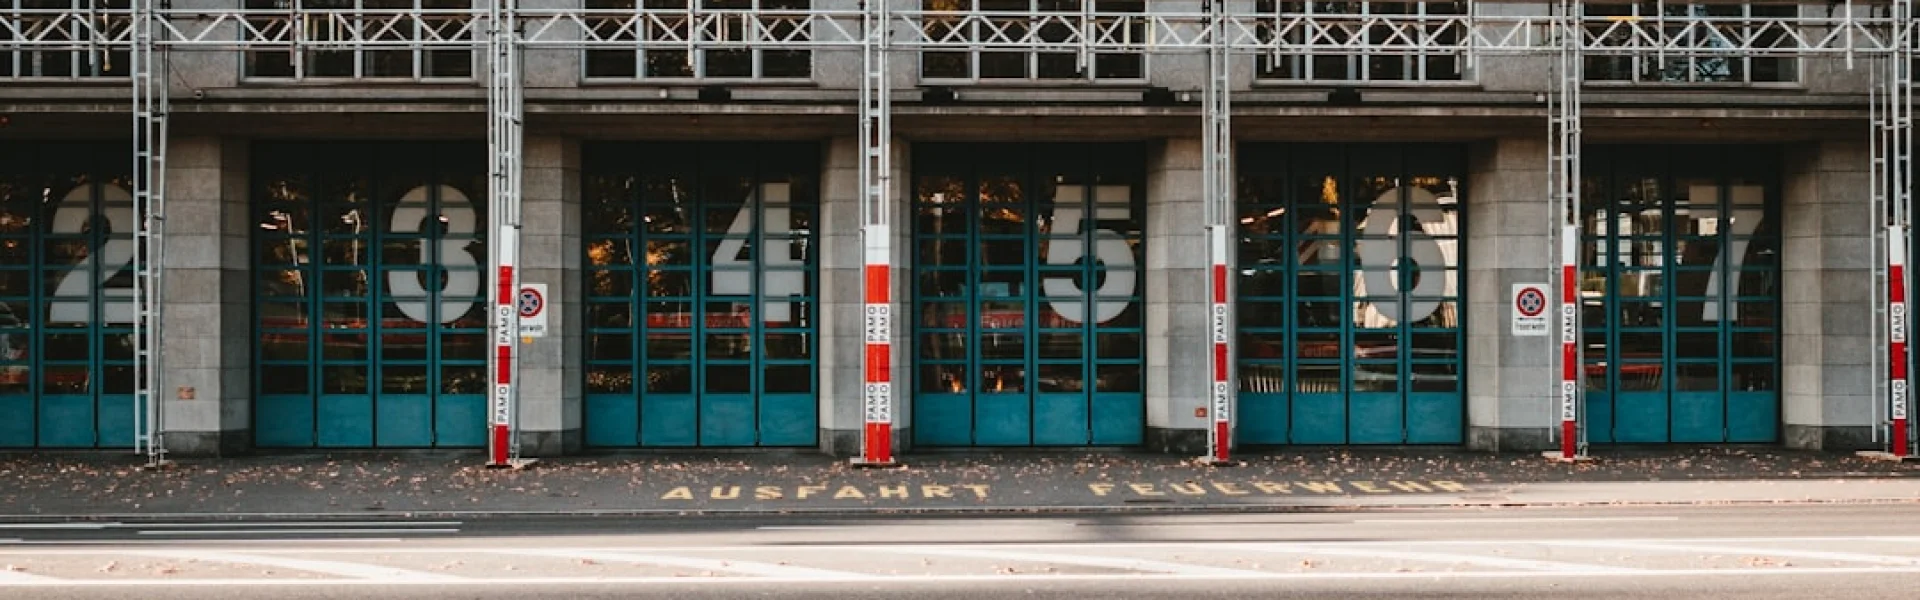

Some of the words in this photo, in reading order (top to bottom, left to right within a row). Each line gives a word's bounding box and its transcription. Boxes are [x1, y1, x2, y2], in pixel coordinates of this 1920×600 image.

[50, 183, 142, 323] 2
[388, 184, 480, 323] 3
[711, 182, 805, 323] 4
[1043, 184, 1137, 323] 5
[1354, 186, 1445, 323] 6
[1688, 183, 1764, 322] 7
[500, 307, 509, 343] PAMO
[868, 306, 876, 341] PAMO
[880, 306, 888, 341] PAMO
[1217, 306, 1225, 341] PAMO
[1565, 306, 1573, 341] PAMO
[1893, 305, 1902, 340] PAMO
[498, 387, 507, 422] PAMO
[868, 385, 876, 420] PAMO
[880, 385, 888, 420] PAMO
[1218, 384, 1226, 419] PAMO
[1565, 383, 1573, 418] PAMO
[1895, 381, 1904, 416] PAMO
[660, 483, 991, 500] AUSFAHRT
[1088, 480, 1466, 497] FEUERWEHR
